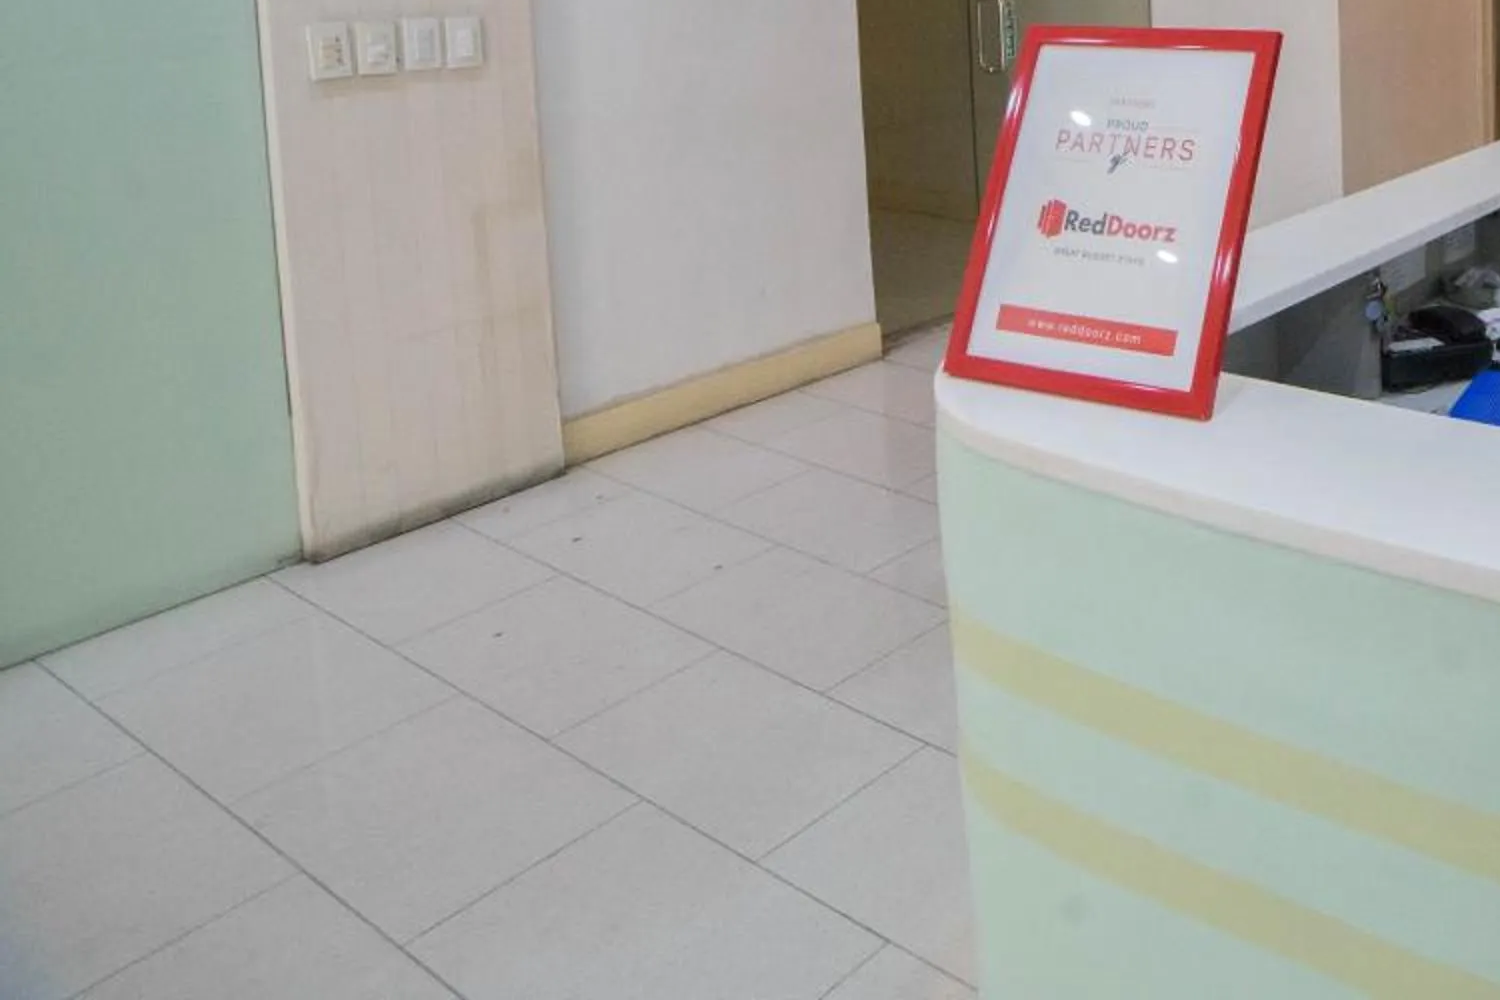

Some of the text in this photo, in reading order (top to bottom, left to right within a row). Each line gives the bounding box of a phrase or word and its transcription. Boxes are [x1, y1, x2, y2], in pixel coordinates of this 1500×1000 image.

[1107, 118, 1150, 132] PROUD
[1055, 128, 1196, 162] PARTNERS
[1064, 208, 1177, 243] RedDoorz
[1027, 318, 1142, 346] www.reddoorz.com
